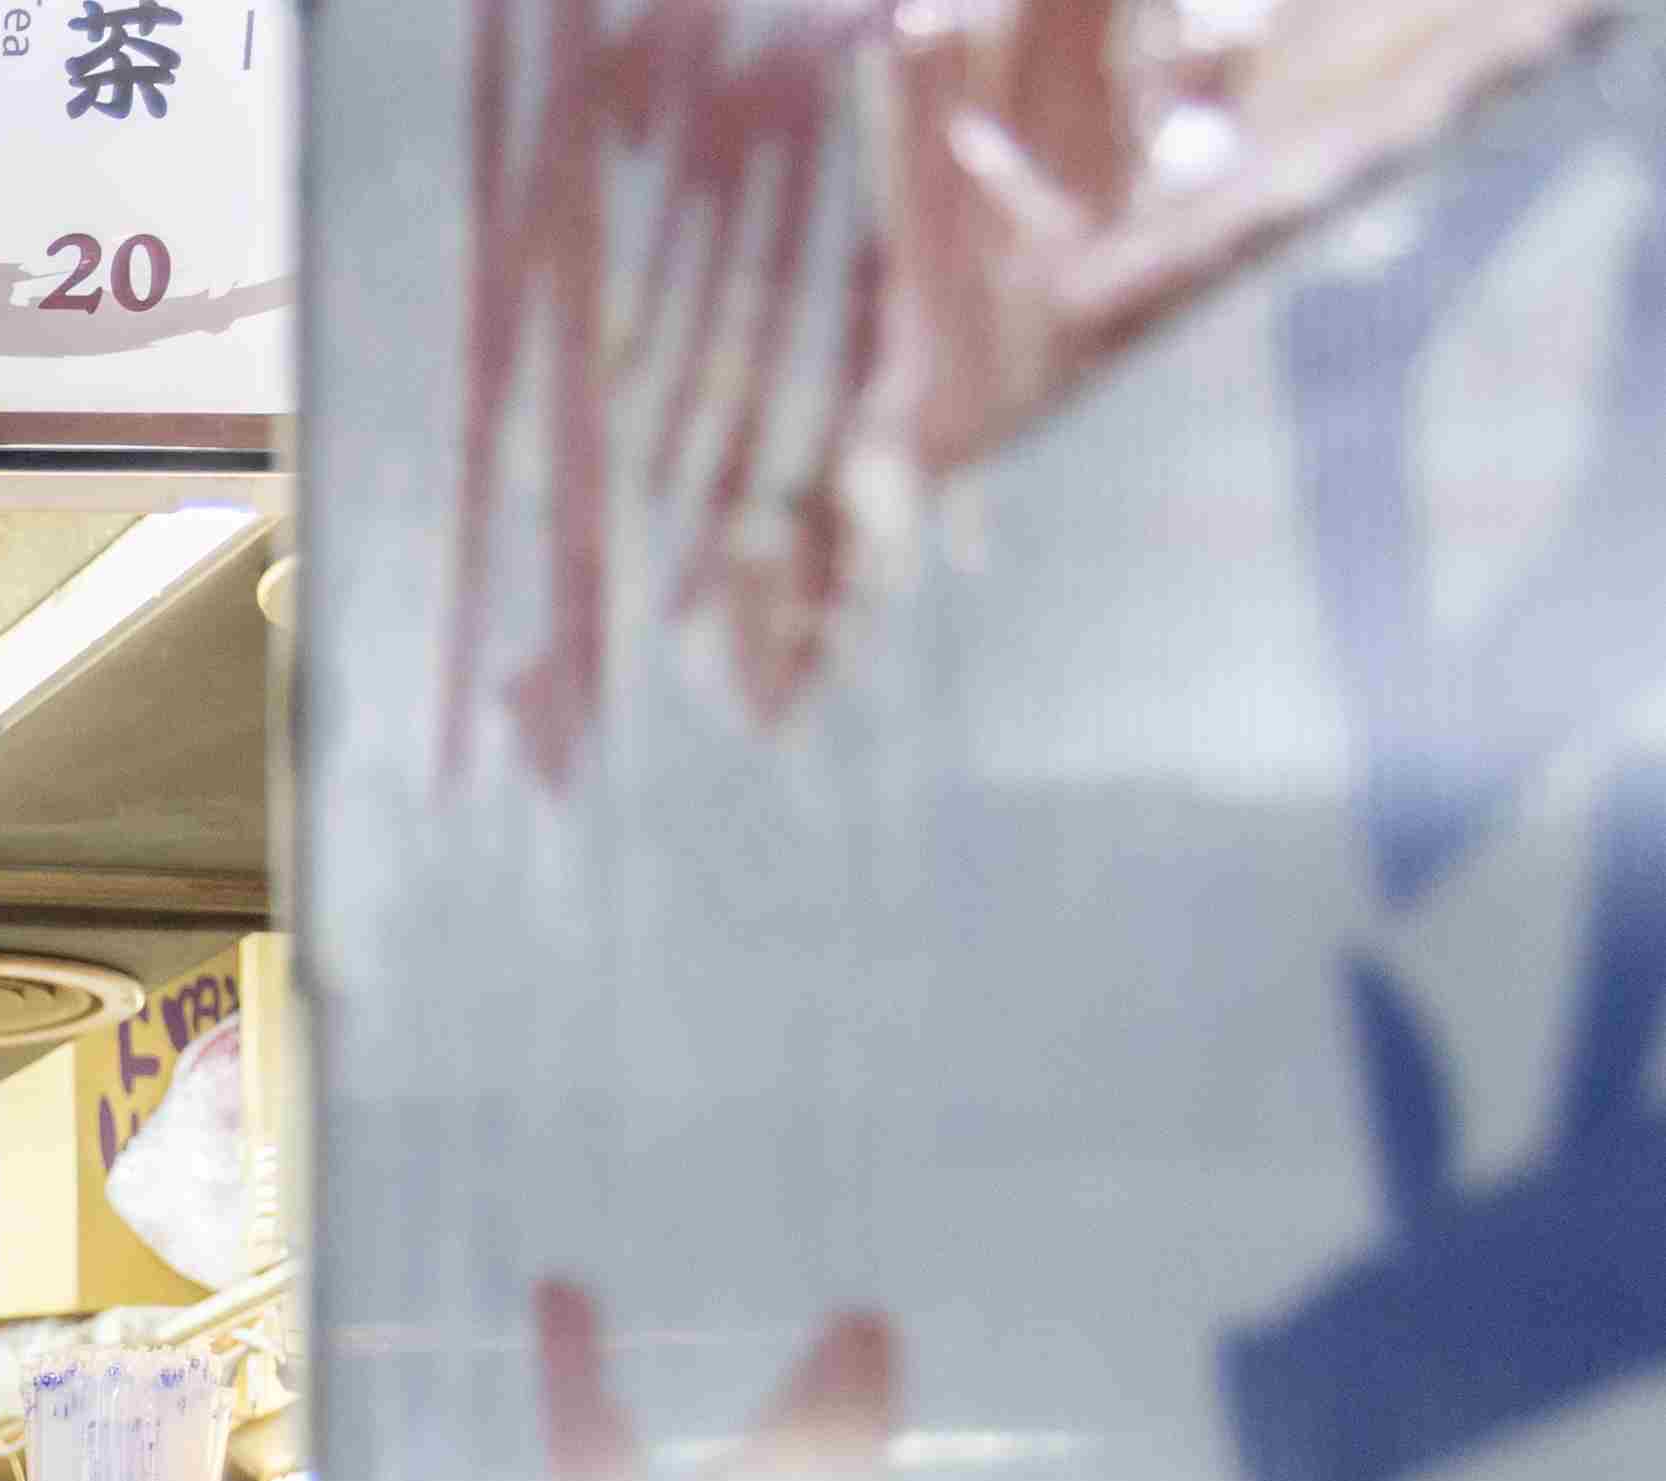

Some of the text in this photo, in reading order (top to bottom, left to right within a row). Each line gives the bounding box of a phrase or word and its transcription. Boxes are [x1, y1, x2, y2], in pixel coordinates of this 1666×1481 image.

[1, 0, 42, 57] ea
[66, 0, 182, 118] 茶
[37, 233, 170, 315] 20
